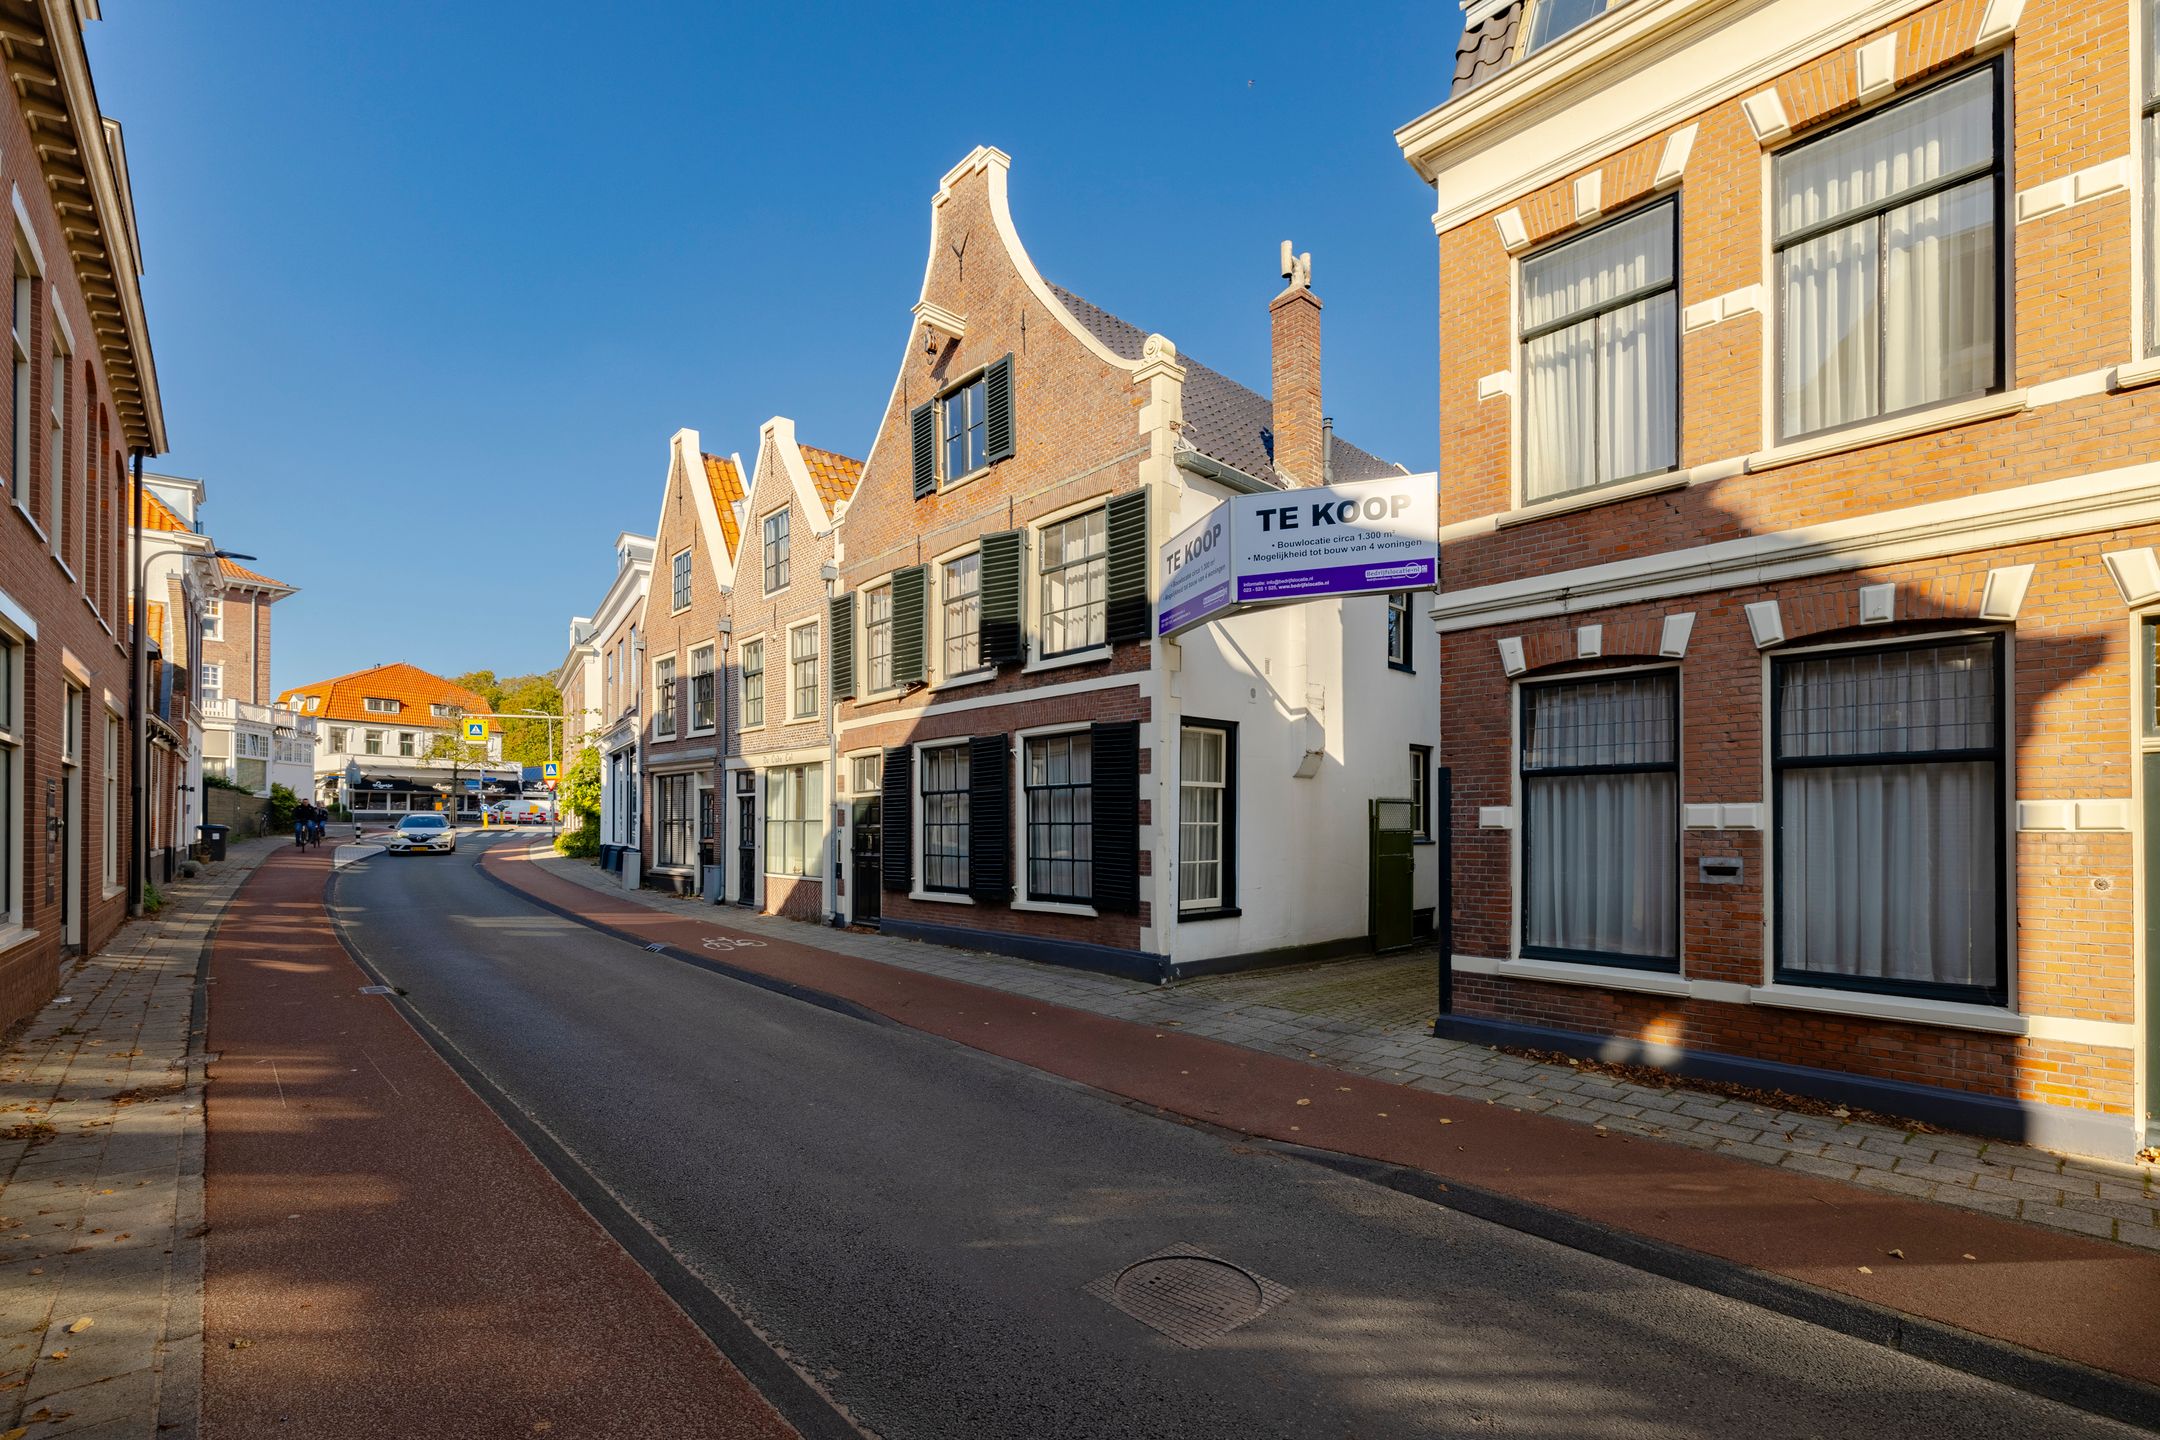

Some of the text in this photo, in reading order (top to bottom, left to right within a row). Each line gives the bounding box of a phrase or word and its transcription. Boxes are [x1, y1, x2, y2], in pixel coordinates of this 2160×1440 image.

[1256, 494, 1412, 532] TE KOOP
[1166, 523, 1222, 575] TE KOOP
[1253, 538, 1422, 563] Mogelijkheid tot bouw van 4 woningen
[1277, 536, 1331, 550] Bouwlocatie
[1333, 534, 1355, 544] circa
[1358, 531, 1381, 542] 1.300
[1279, 580, 1330, 590] www.bedrijfslocatie.nl
